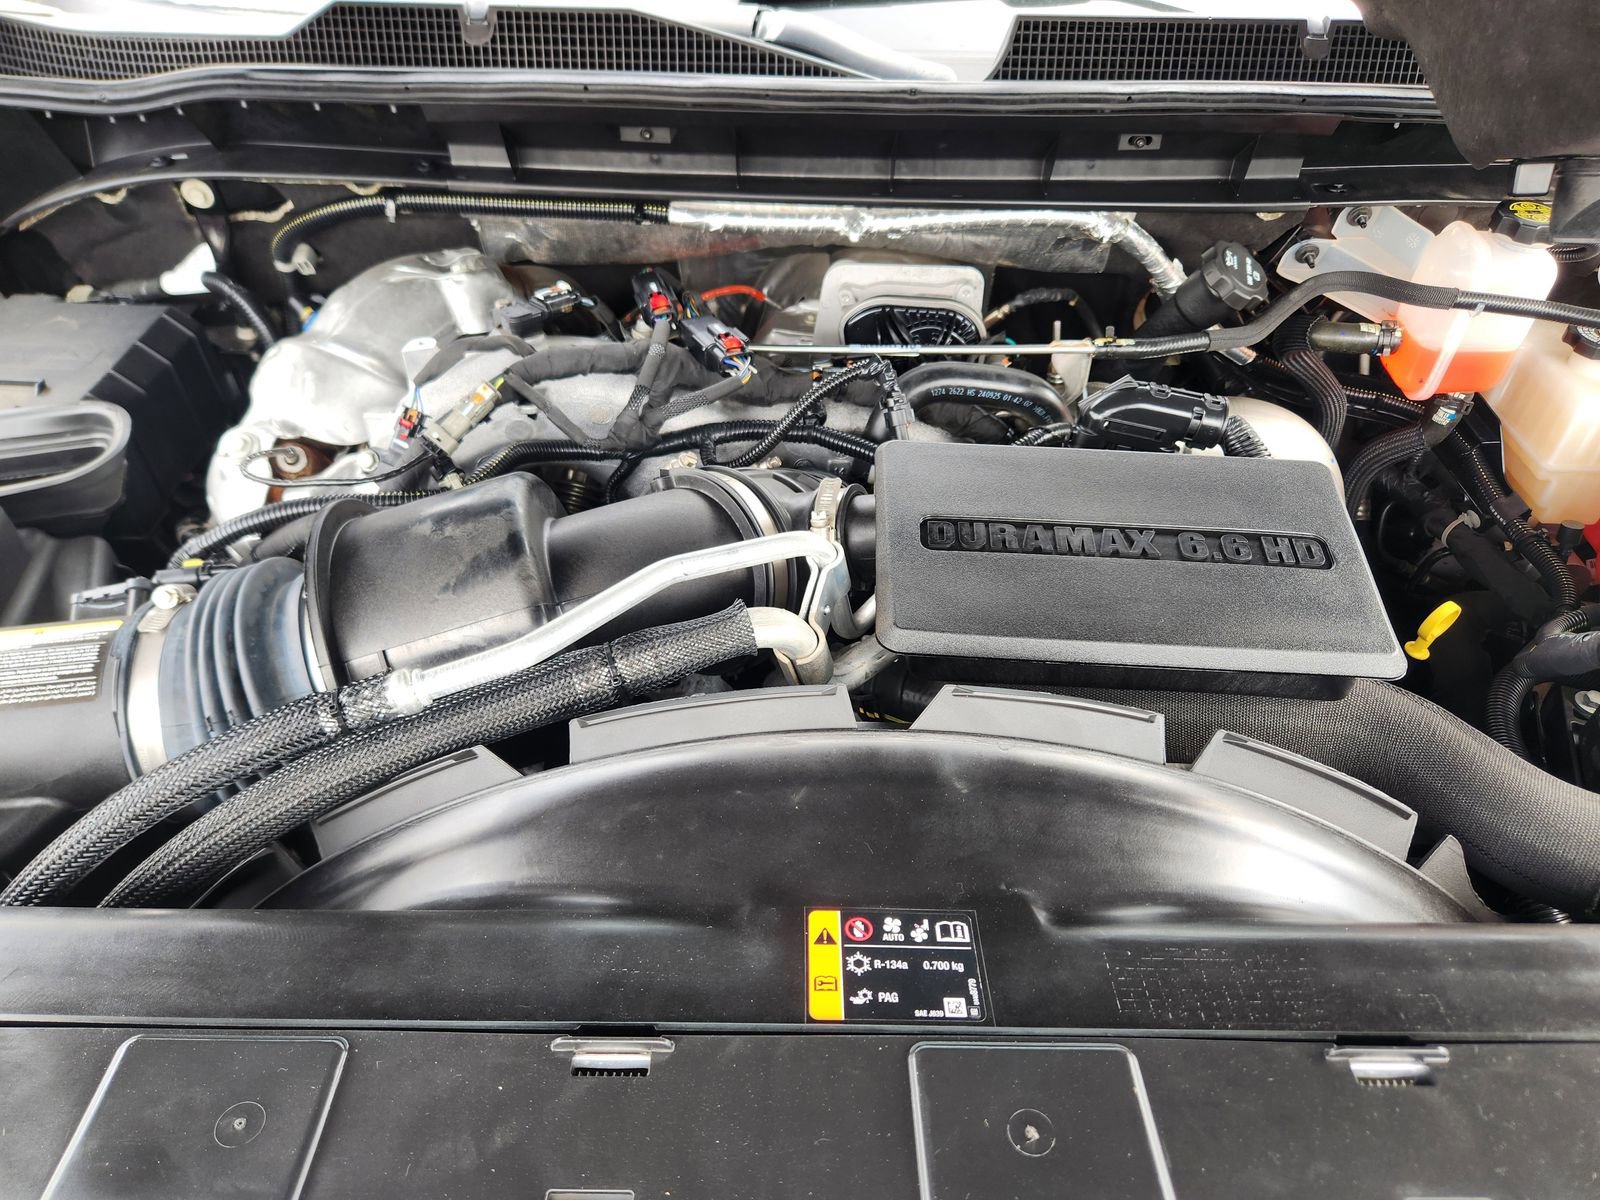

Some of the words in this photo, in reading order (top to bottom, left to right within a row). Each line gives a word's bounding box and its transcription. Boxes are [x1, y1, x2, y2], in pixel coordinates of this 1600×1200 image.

[927, 520, 1161, 559] DURAMAX
[1177, 531, 1252, 562] 6.6
[1261, 535, 1327, 567] HD
[882, 933, 904, 942] AUTO
[874, 959, 908, 970] R-134a
[923, 960, 950, 970] 0.700
[951, 961, 964, 972] kg
[878, 991, 899, 1003] PAG
